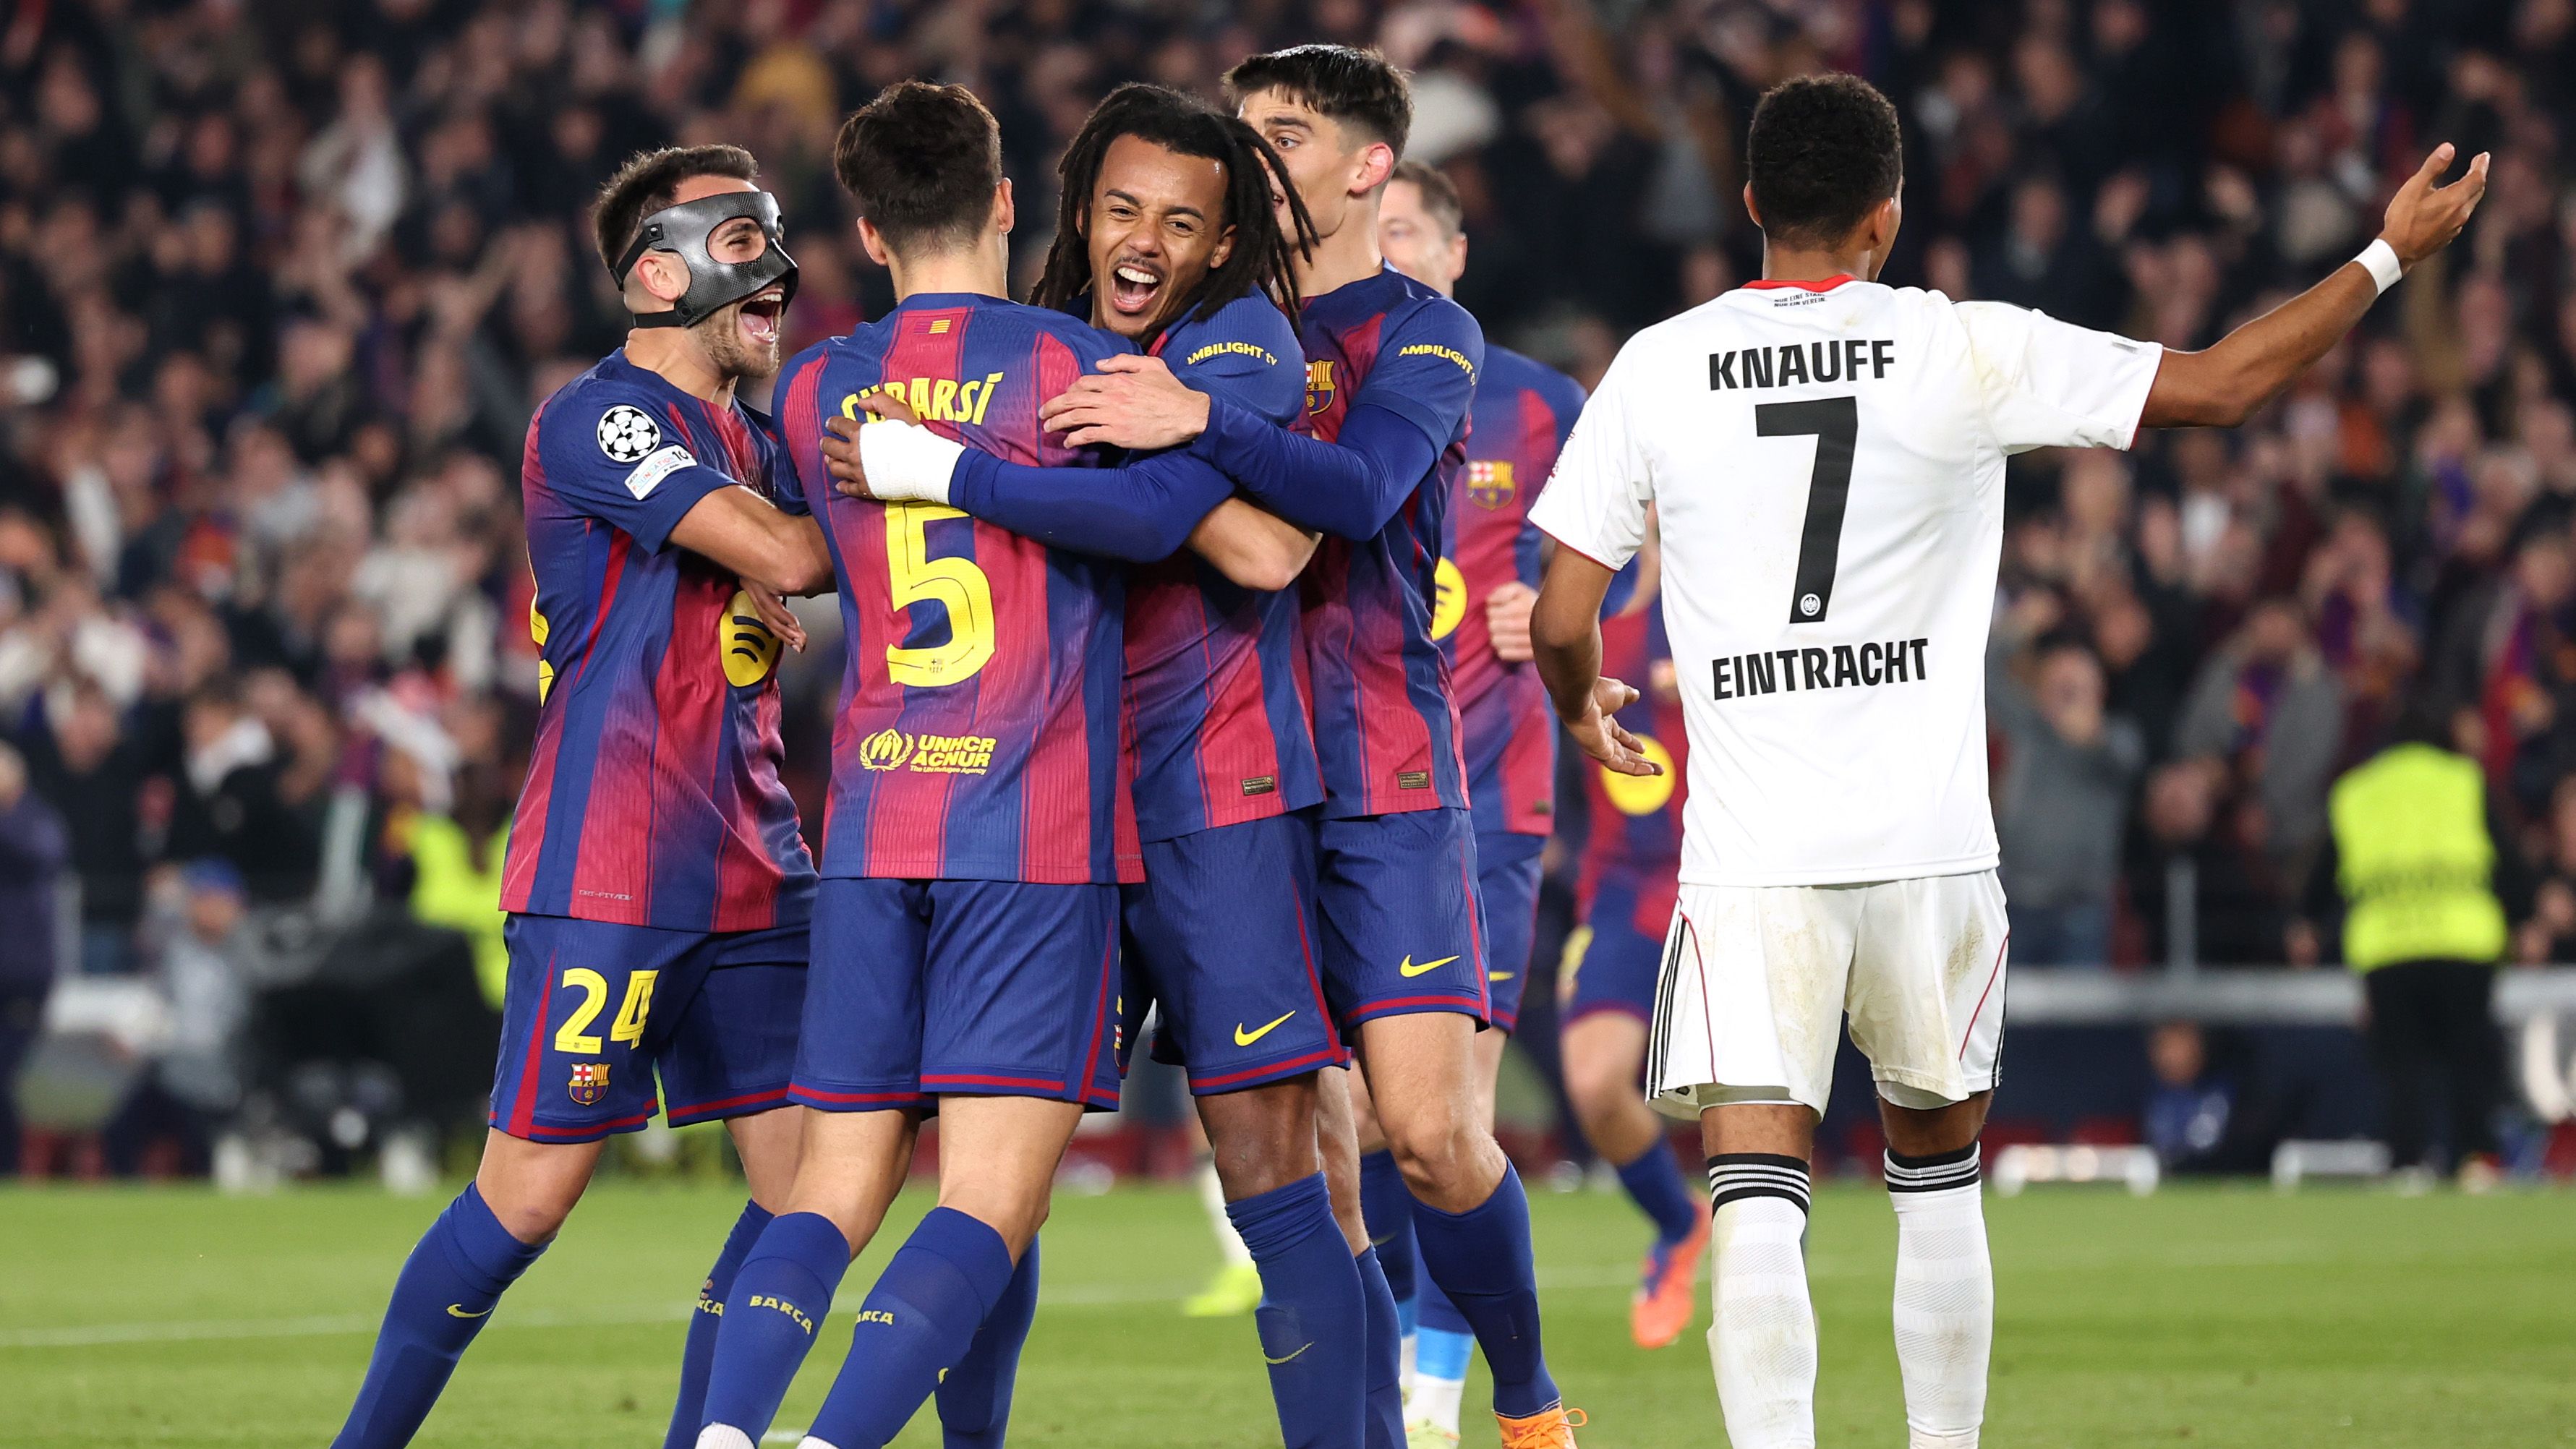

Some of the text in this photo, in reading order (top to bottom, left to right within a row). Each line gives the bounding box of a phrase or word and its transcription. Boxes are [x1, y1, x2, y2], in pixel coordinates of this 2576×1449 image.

[1790, 293, 1803, 302] EINE
[1399, 344, 1473, 374] AMBILIGHT
[1709, 340, 1895, 390] KNAUFF
[1755, 396, 1859, 624] 7
[885, 499, 995, 687] 5
[1712, 638, 1928, 701] EINTRACHT
[910, 751, 991, 767] ACNUR
[918, 735, 997, 752] UNHCR
[555, 967, 660, 1054] 24
[697, 1299, 724, 1317] RÇA
[749, 1295, 814, 1335] BARÇA
